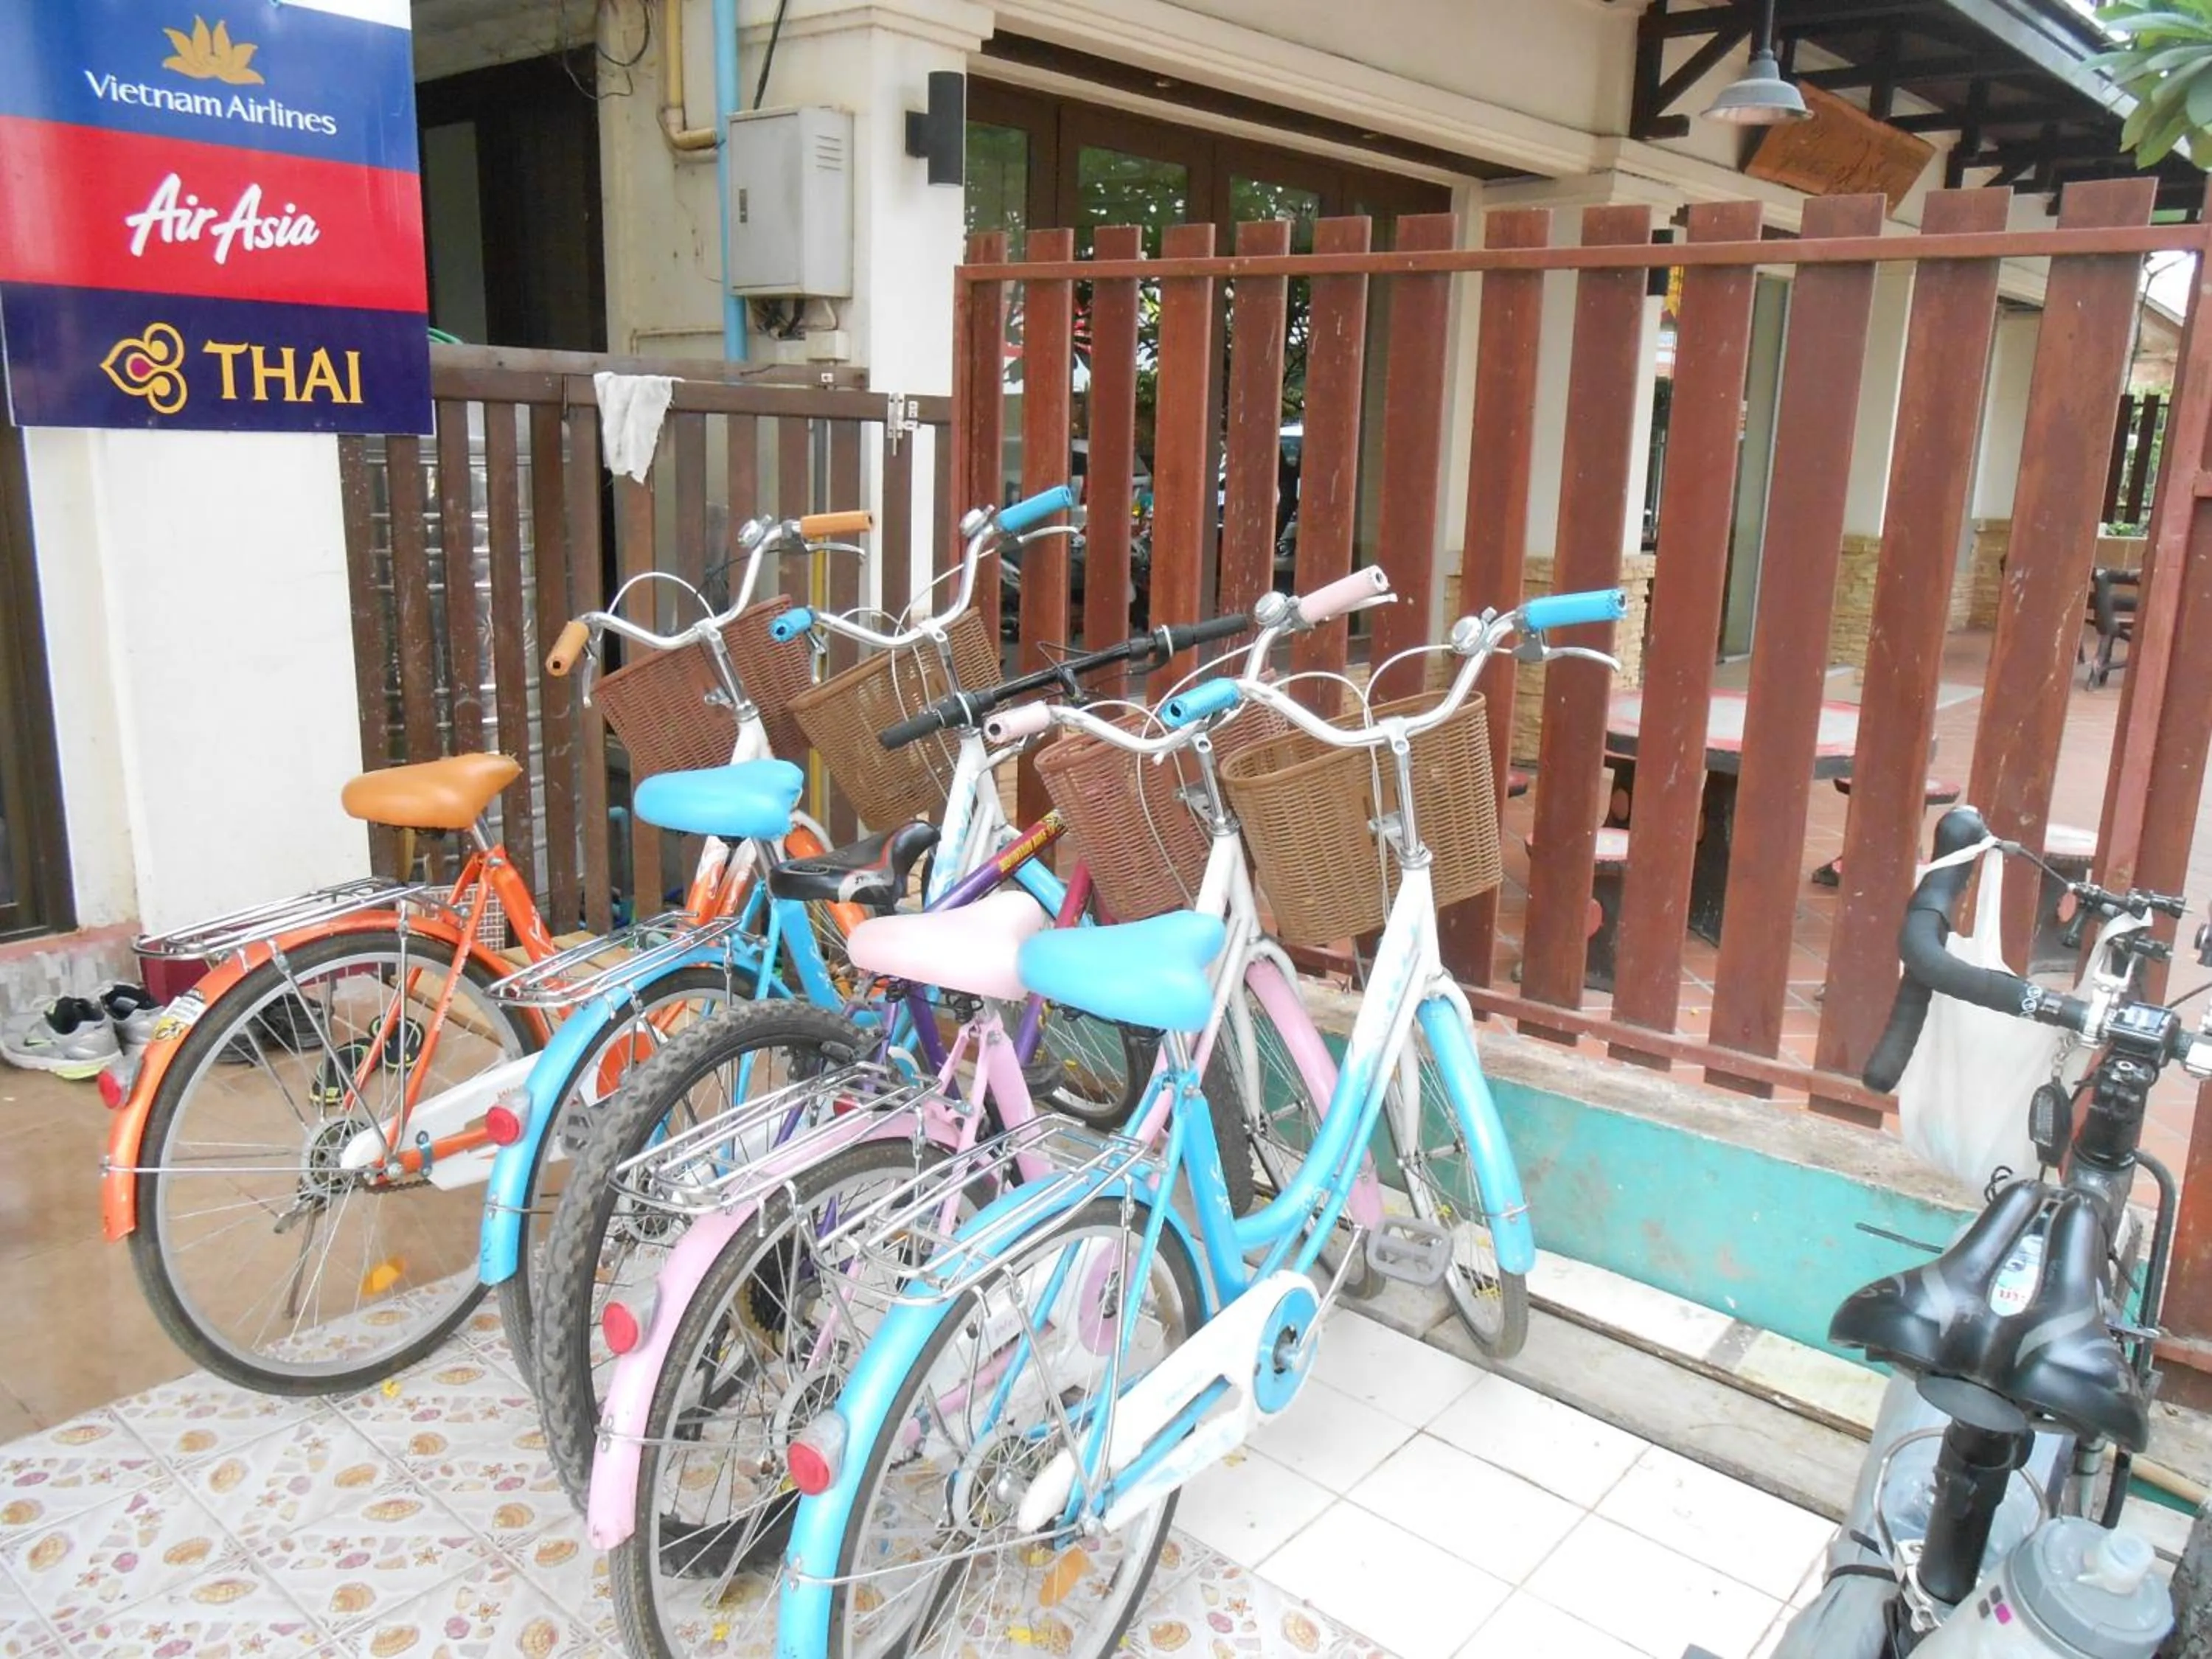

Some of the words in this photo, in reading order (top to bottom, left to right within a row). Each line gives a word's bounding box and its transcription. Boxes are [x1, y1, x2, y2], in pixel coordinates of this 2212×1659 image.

[84, 70, 223, 118] Vietnam
[226, 94, 337, 136] Airlines
[202, 339, 364, 404] THAI
